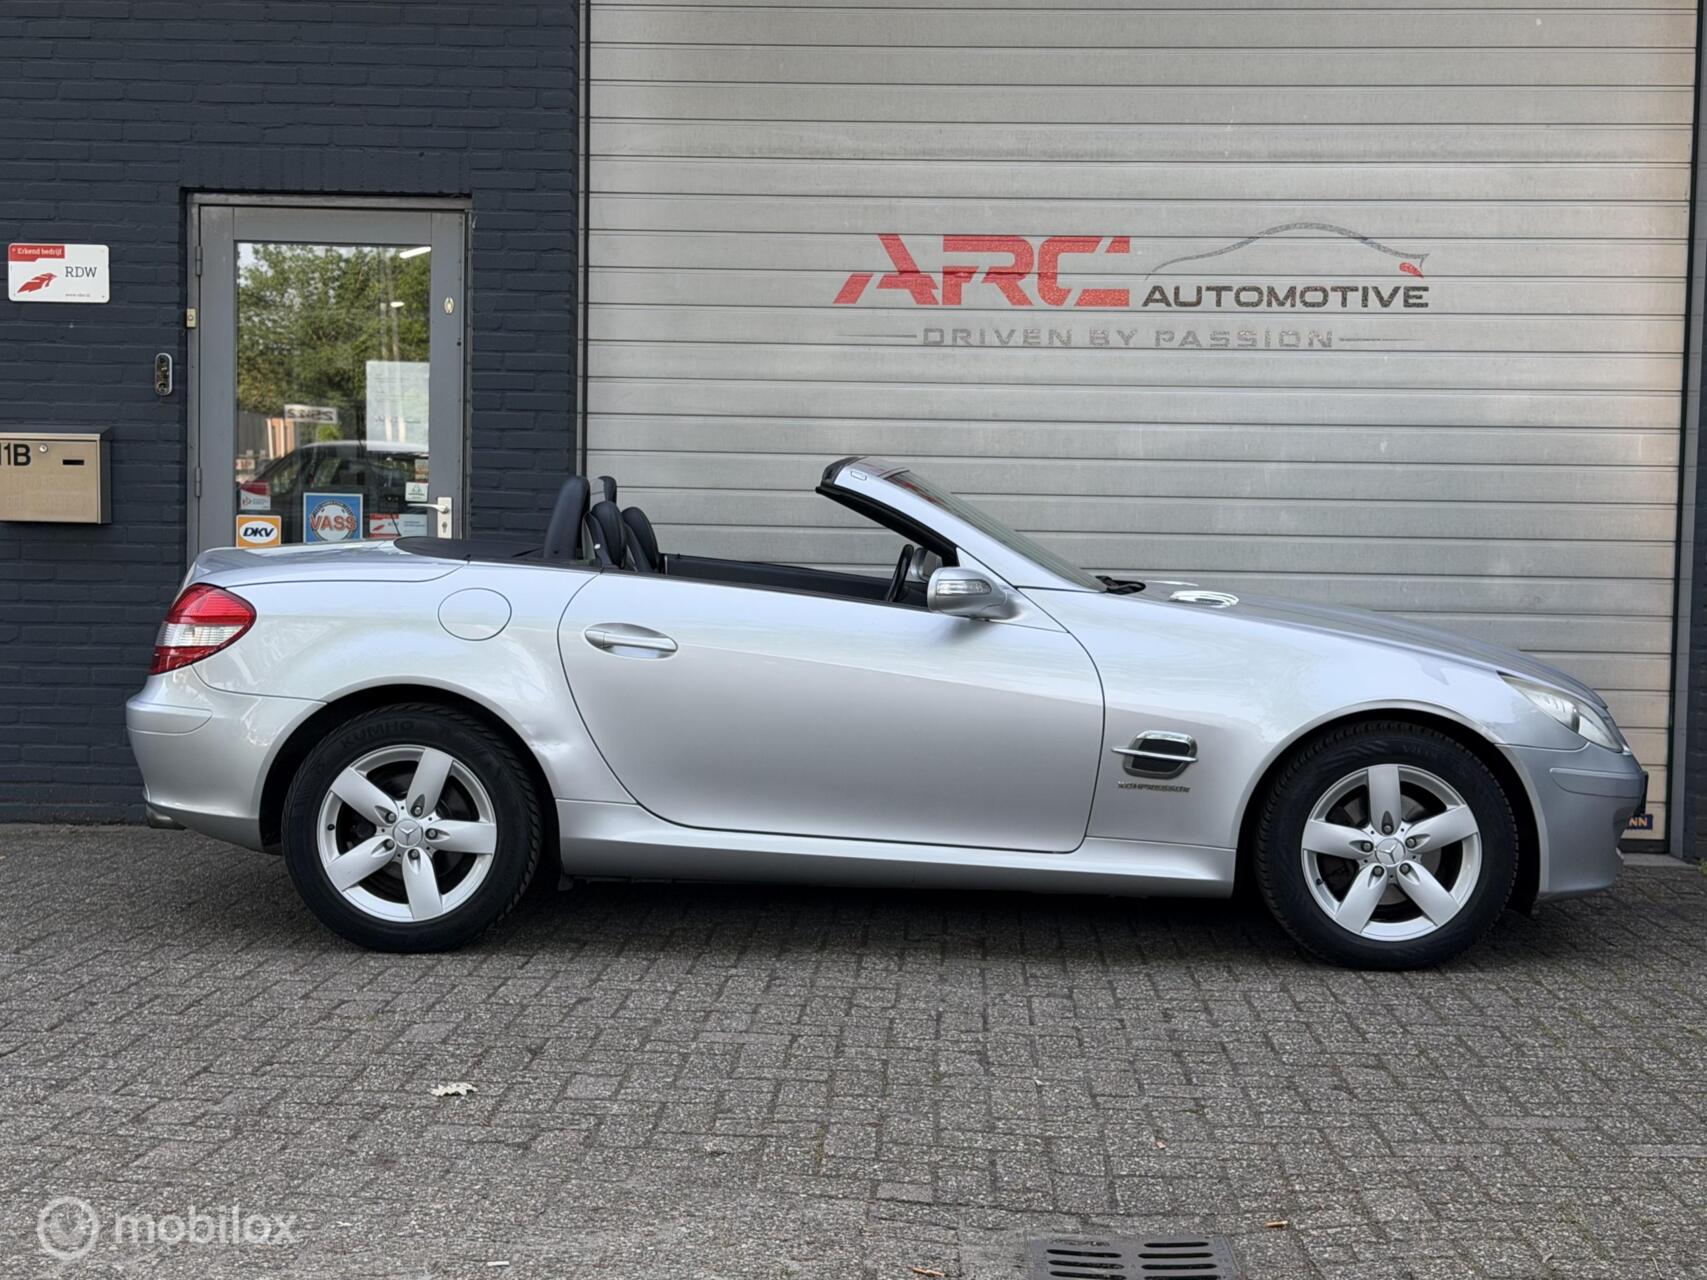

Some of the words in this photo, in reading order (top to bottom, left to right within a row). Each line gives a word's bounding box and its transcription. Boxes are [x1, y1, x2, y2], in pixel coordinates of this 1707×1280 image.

[65, 266, 97, 278] RDW
[833, 233, 1131, 306] ARC
[1142, 285, 1429, 309] AUTOMOTIVE
[922, 327, 1072, 348] DRIVEN
[1089, 328, 1139, 348] BY
[1154, 329, 1333, 349] PASSION
[0, 442, 31, 466] 1B
[242, 526, 275, 538] DKV
[310, 514, 356, 532] VASS
[341, 720, 416, 748] KUMHO
